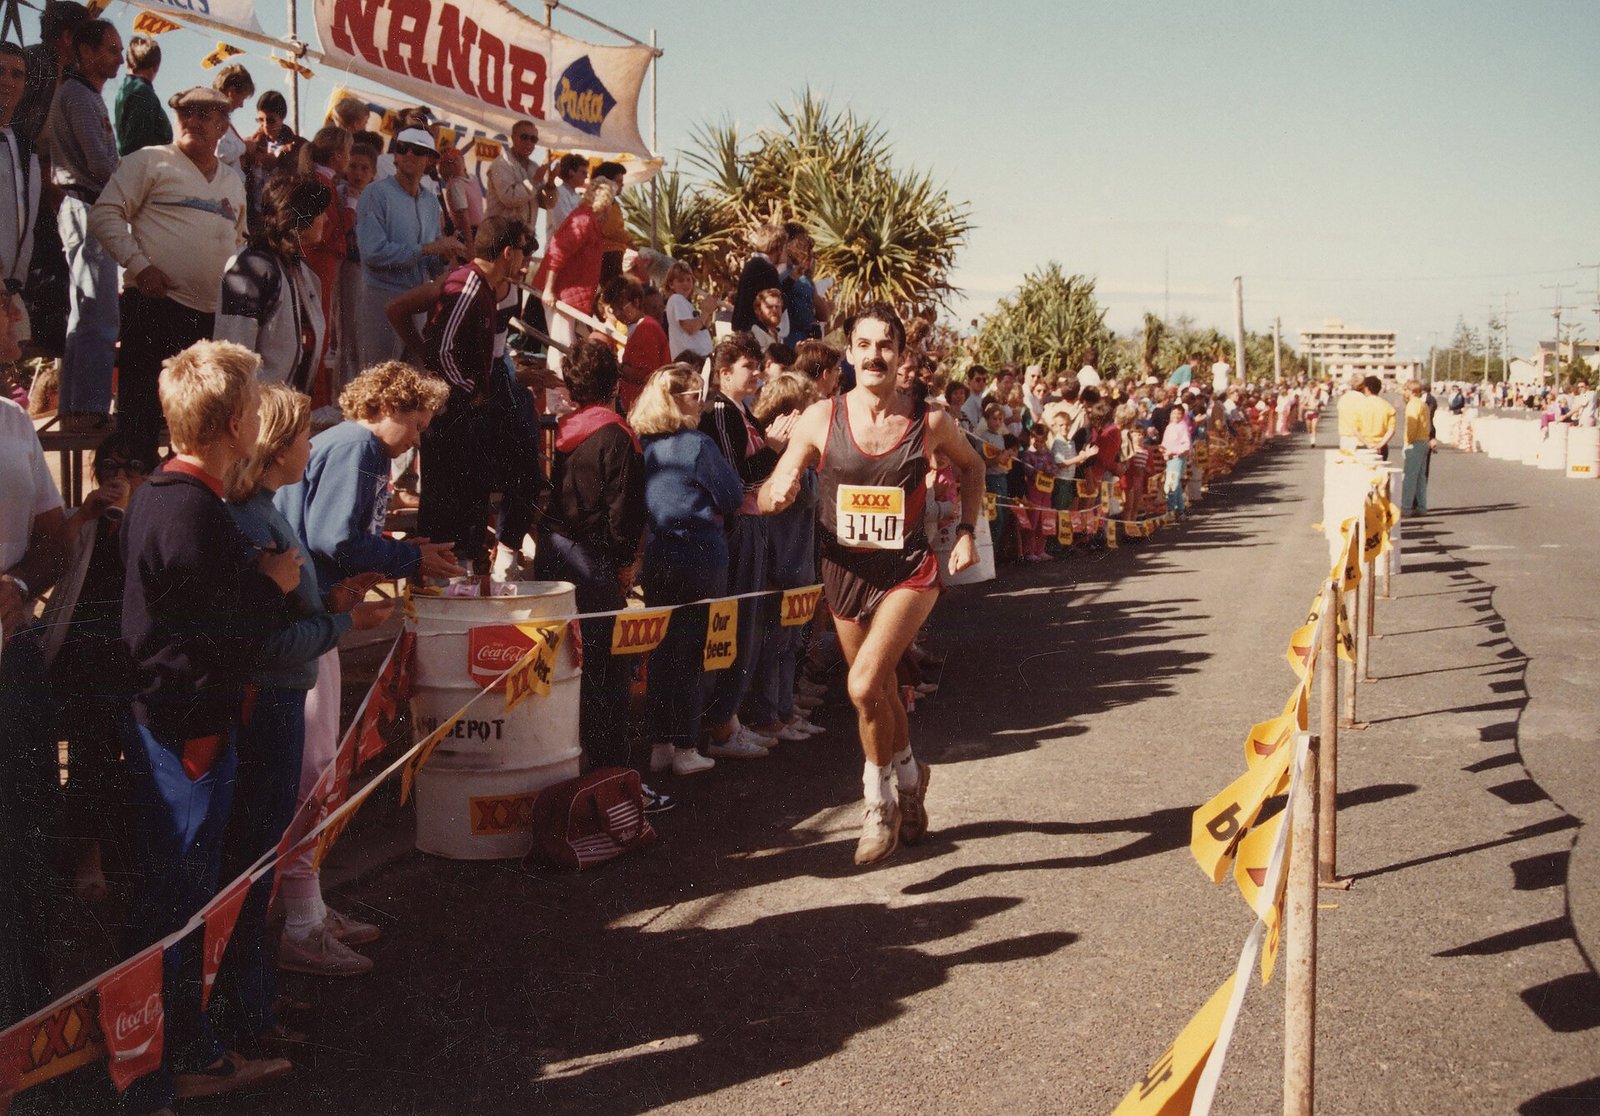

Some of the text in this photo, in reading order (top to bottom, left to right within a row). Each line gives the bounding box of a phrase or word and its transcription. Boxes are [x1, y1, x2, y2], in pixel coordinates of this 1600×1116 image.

[331, 0, 547, 120] NANDA
[851, 493, 891, 507] XXXX
[844, 513, 897, 542] 3140
[617, 616, 667, 648] XXXX
[712, 612, 731, 633] Our
[706, 641, 732, 660] beer.
